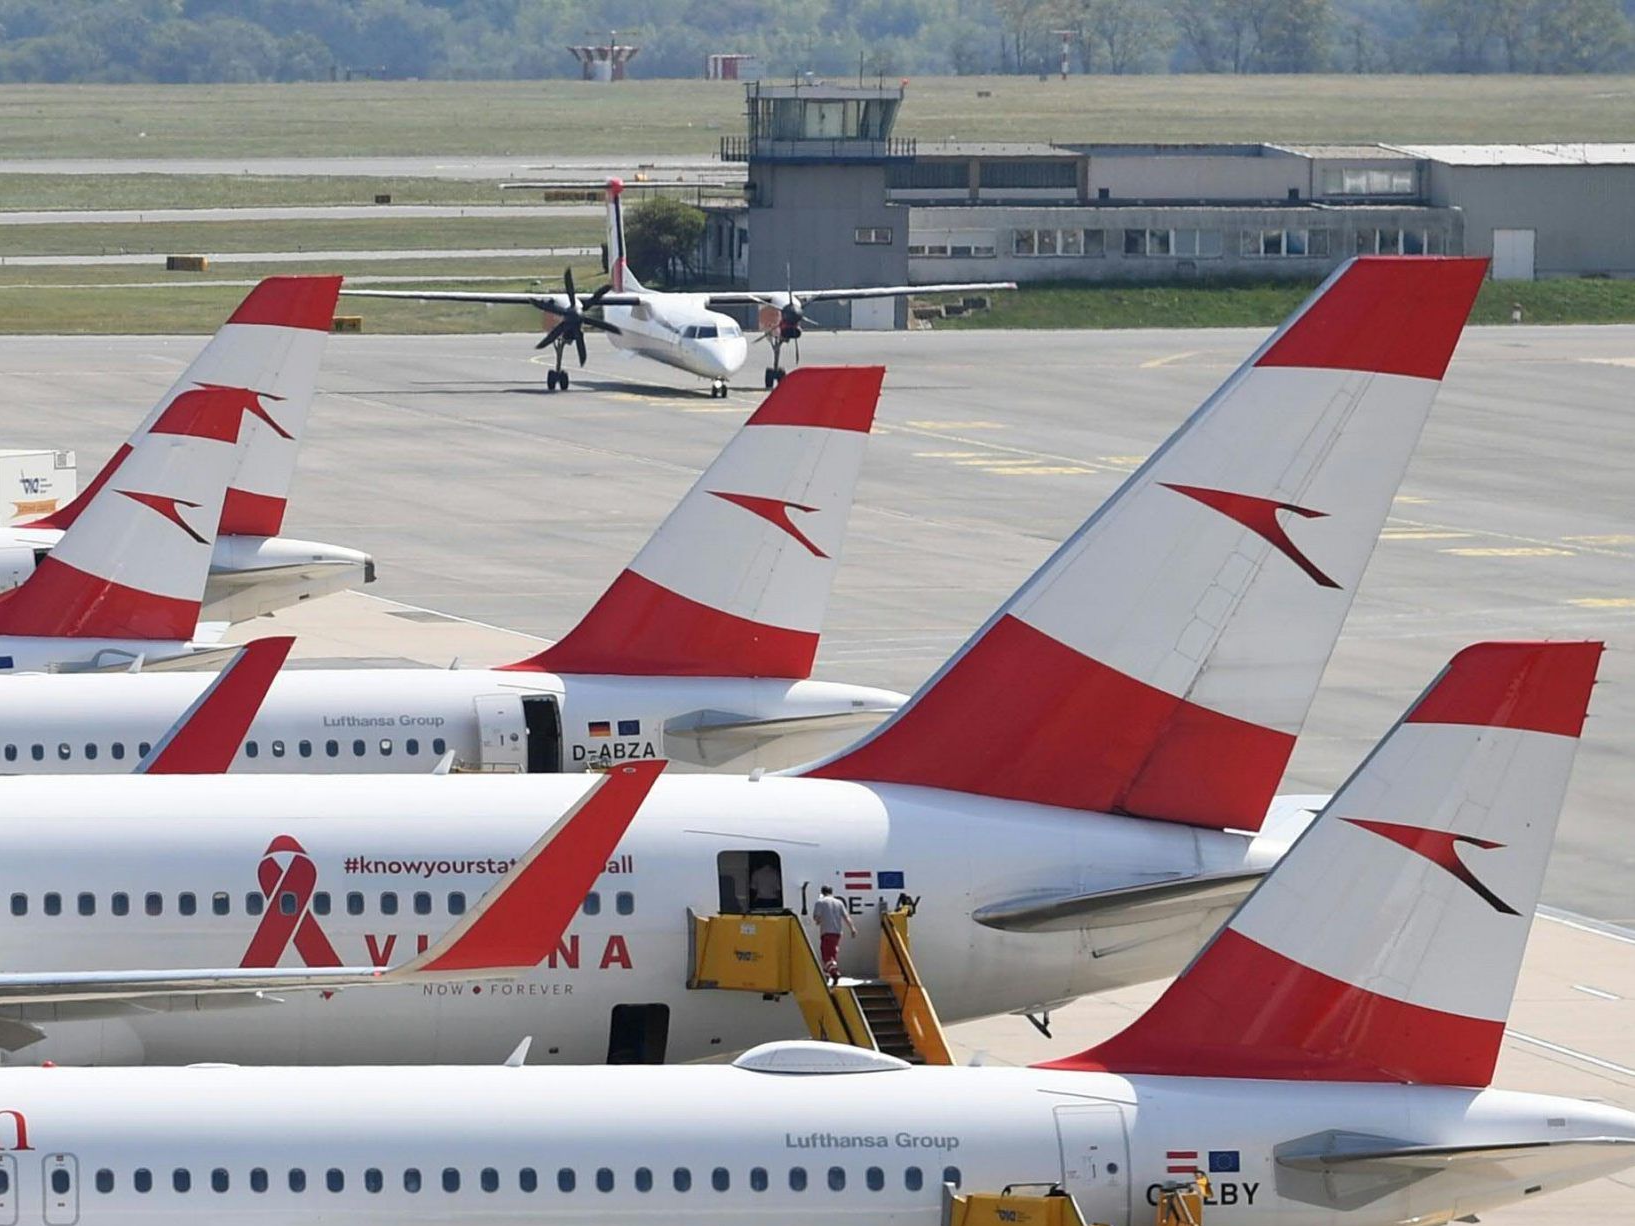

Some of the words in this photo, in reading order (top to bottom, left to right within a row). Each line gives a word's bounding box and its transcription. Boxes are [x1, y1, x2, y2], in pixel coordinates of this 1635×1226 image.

[322, 715, 395, 728] Lufthansa
[399, 714, 445, 729] Group
[572, 741, 656, 761] D-ABZA
[423, 984, 465, 996] NOW
[491, 984, 574, 996] FOREVER
[785, 1132, 889, 1149] Lufthansa
[895, 1131, 960, 1152] Group
